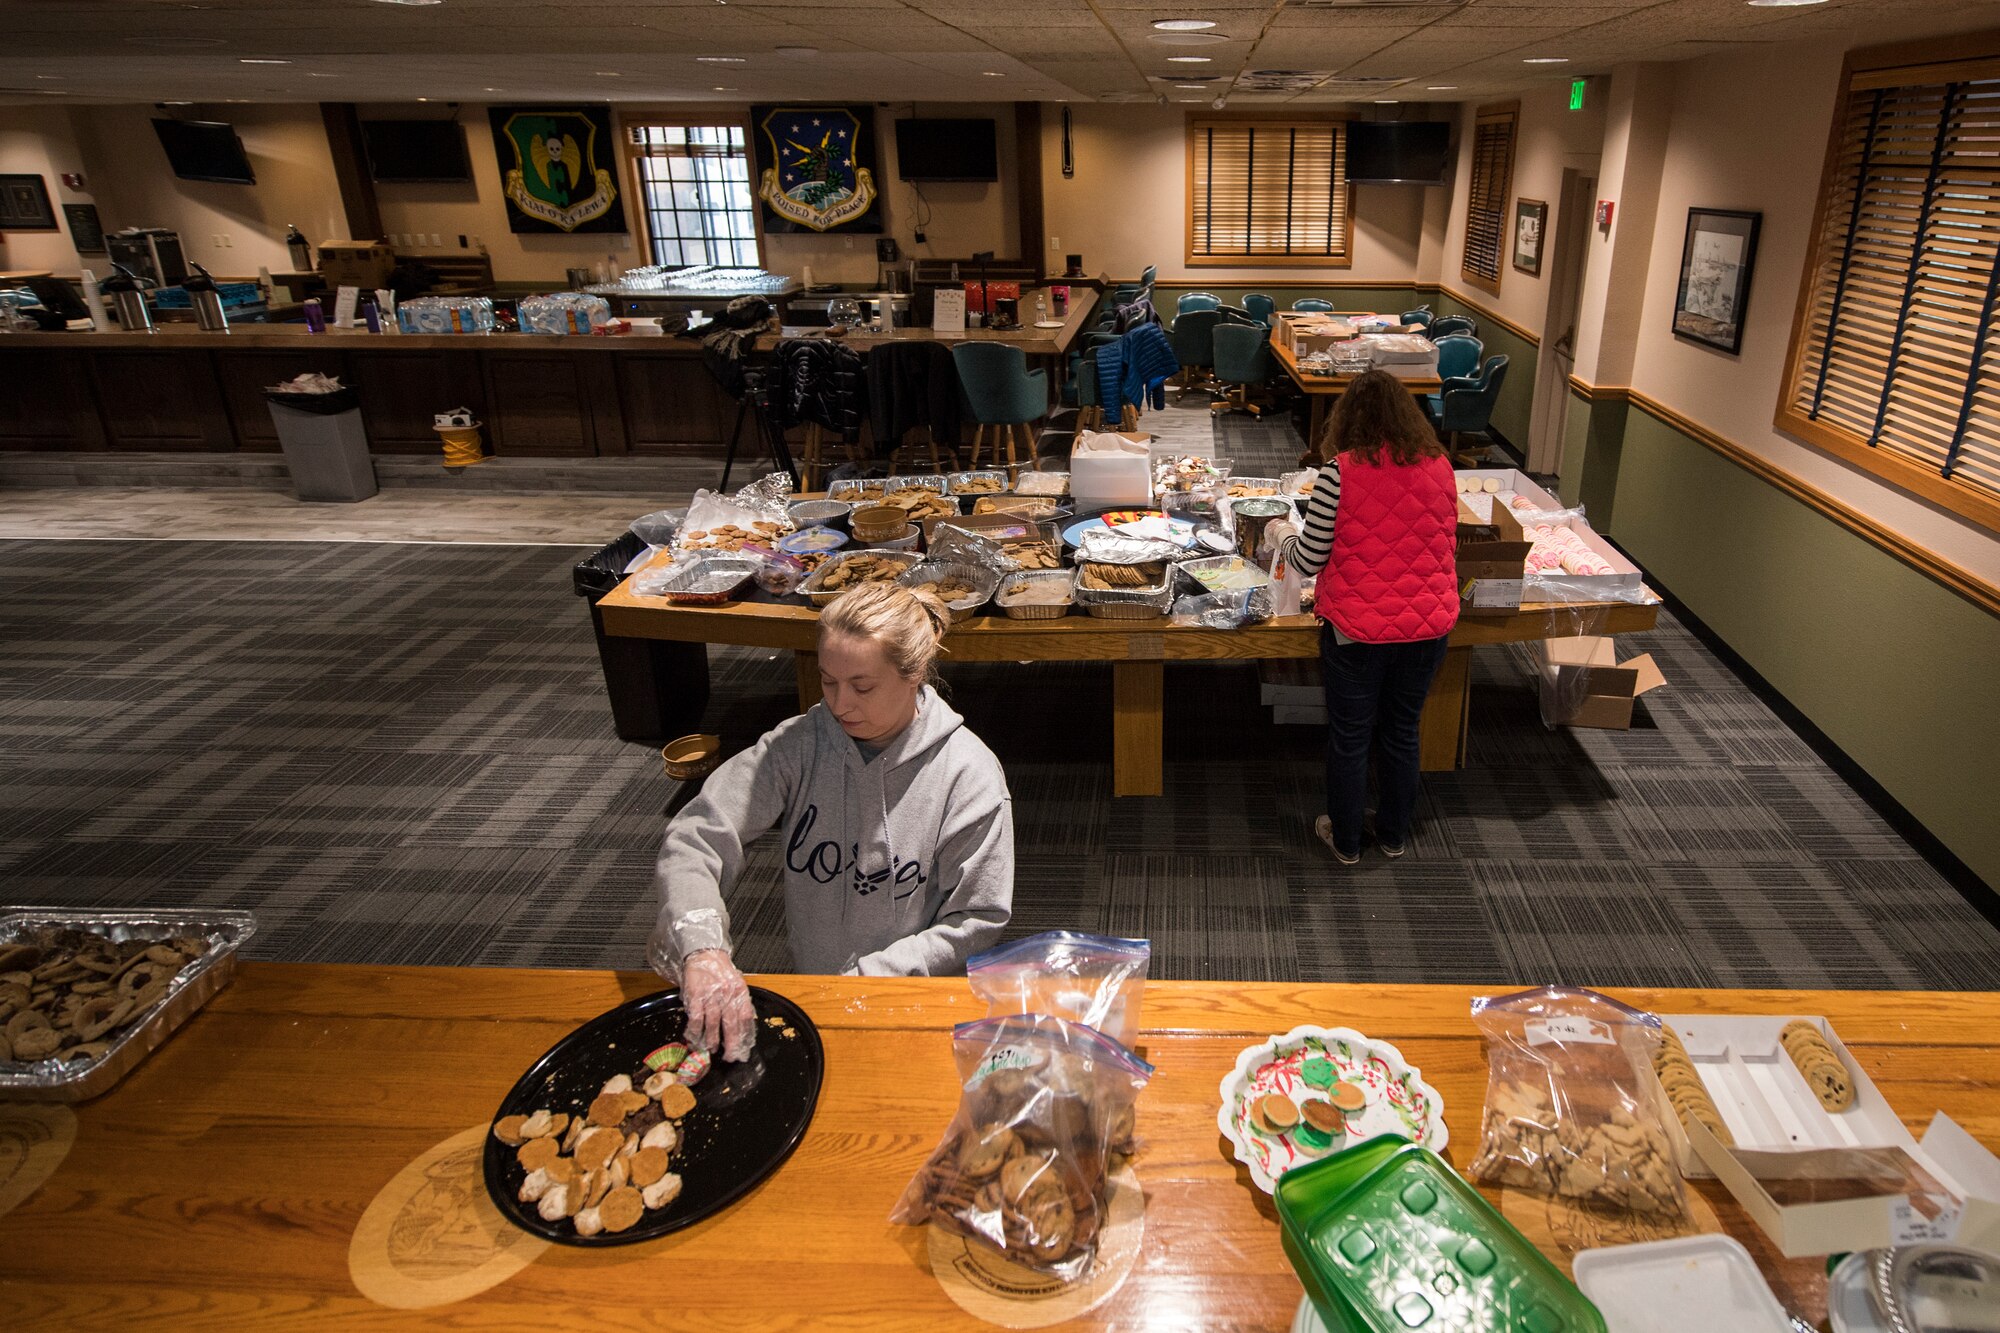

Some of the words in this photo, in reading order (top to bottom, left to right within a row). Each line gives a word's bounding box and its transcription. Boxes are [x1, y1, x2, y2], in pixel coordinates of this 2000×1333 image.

[772, 192, 810, 218] POISED
[813, 214, 834, 226] FOR
[835, 194, 867, 217] PEACE
